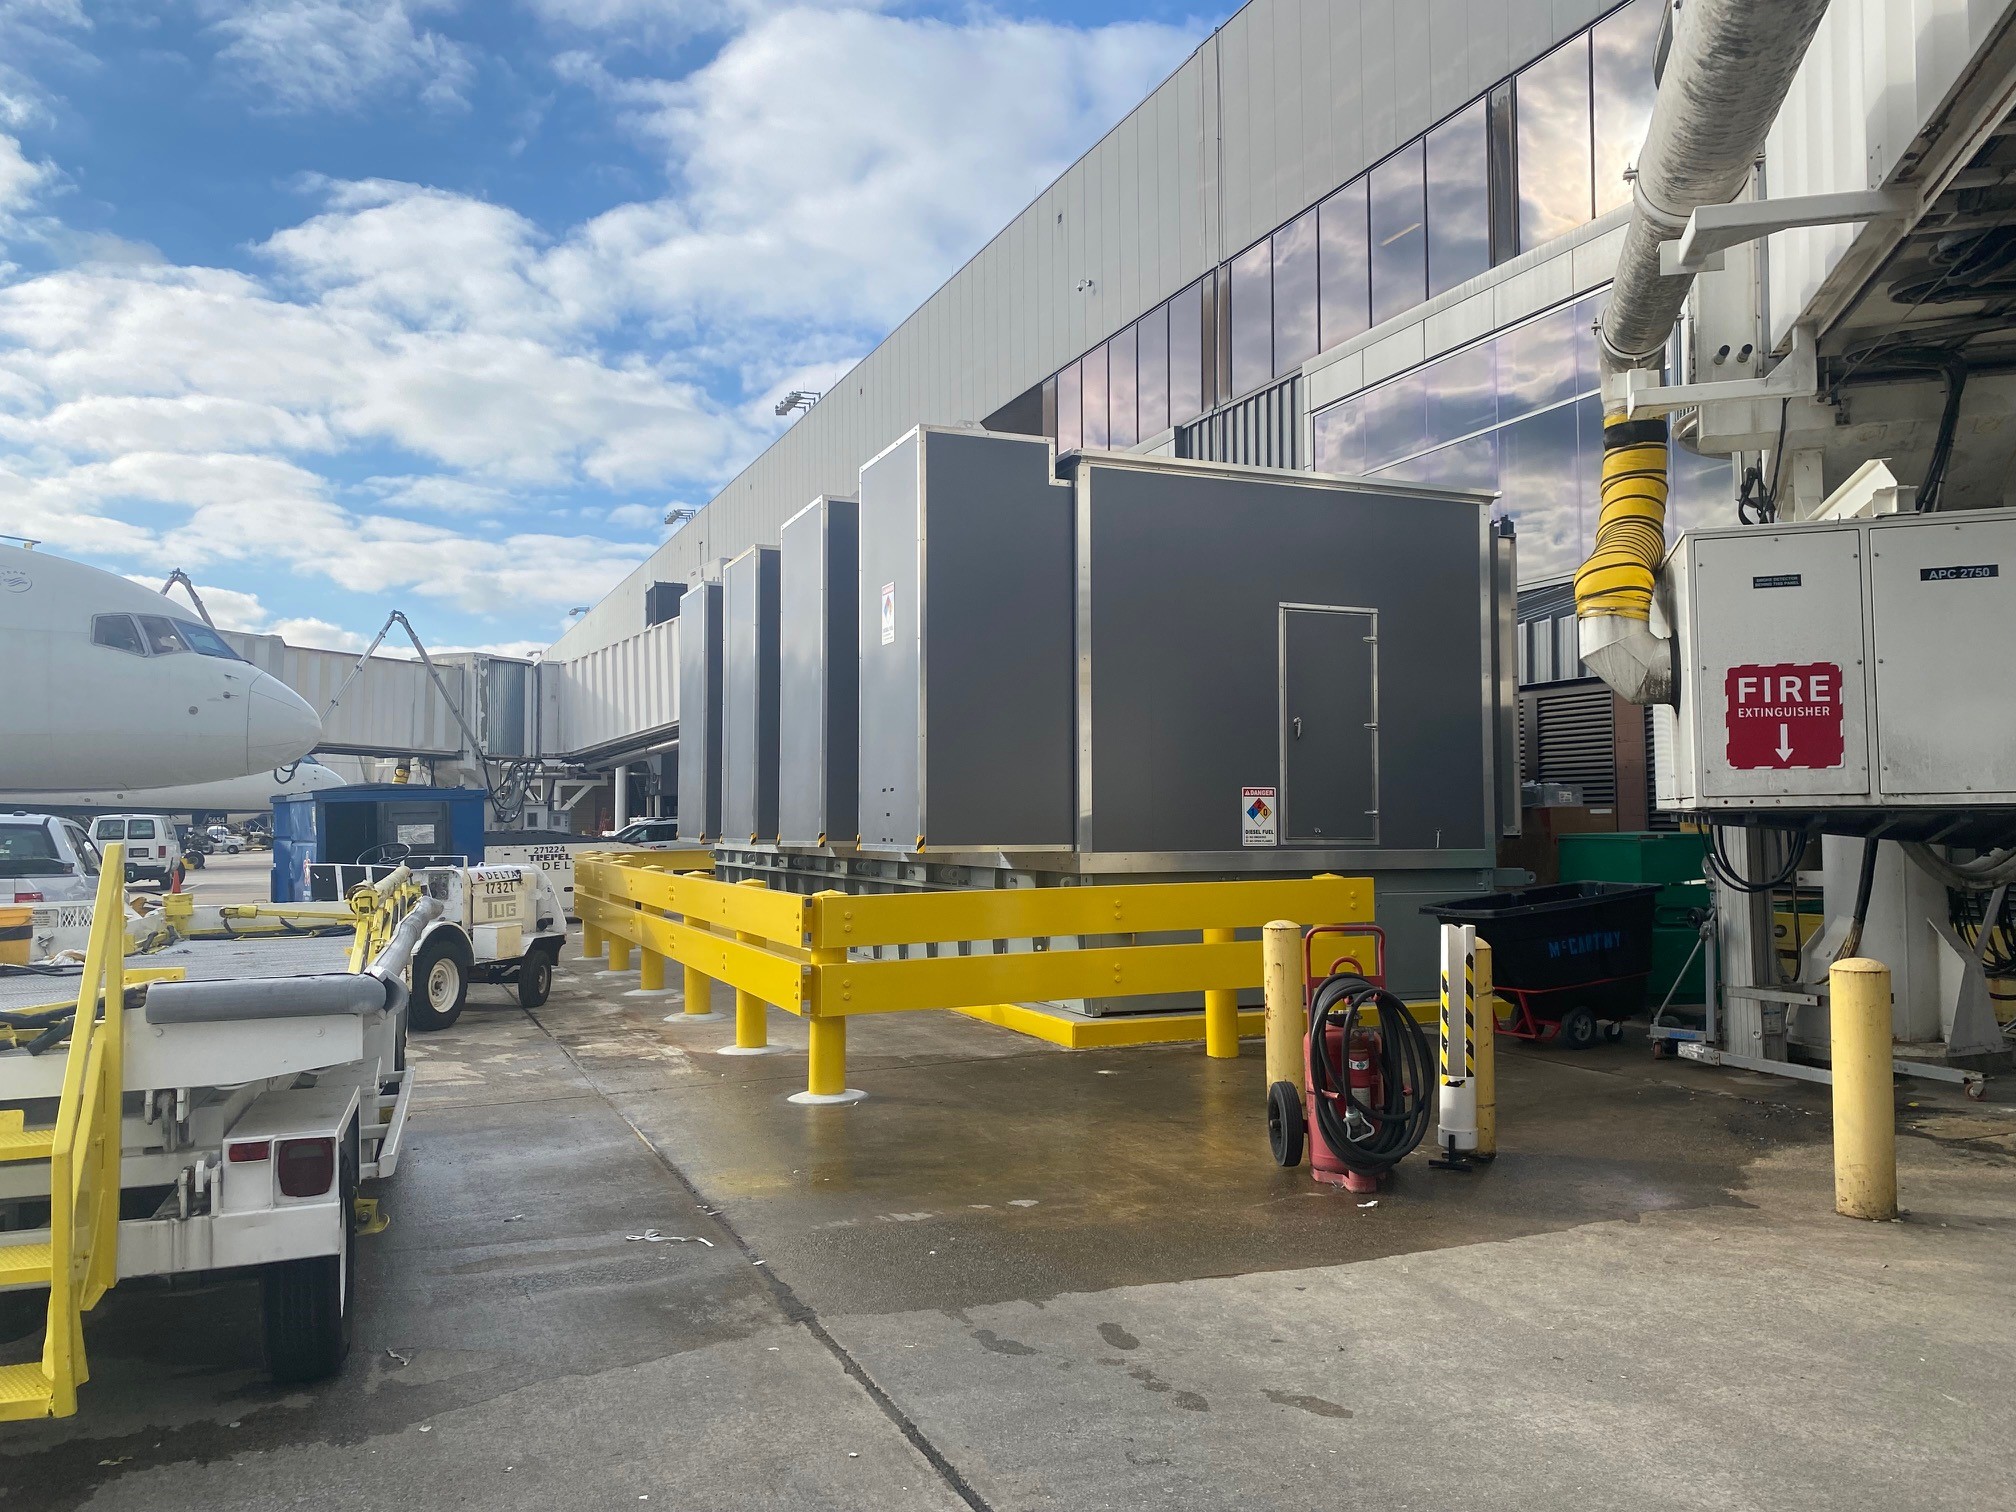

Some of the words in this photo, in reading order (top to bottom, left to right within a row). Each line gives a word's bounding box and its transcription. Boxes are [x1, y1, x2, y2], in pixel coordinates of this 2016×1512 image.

[1929, 569, 1957, 580] APC
[1960, 567, 1990, 578] 2750
[1738, 675, 1831, 703] FIRE
[1738, 706, 1830, 718] EXTINGUISHER
[1257, 801, 1262, 809] 2
[1263, 808, 1268, 817] 0
[208, 816, 225, 824] 5654
[533, 846, 565, 854] 271224
[528, 853, 572, 861] TREPEL
[485, 870, 517, 880] DELTA
[485, 881, 514, 894] 17321
[482, 895, 517, 918] TUG
